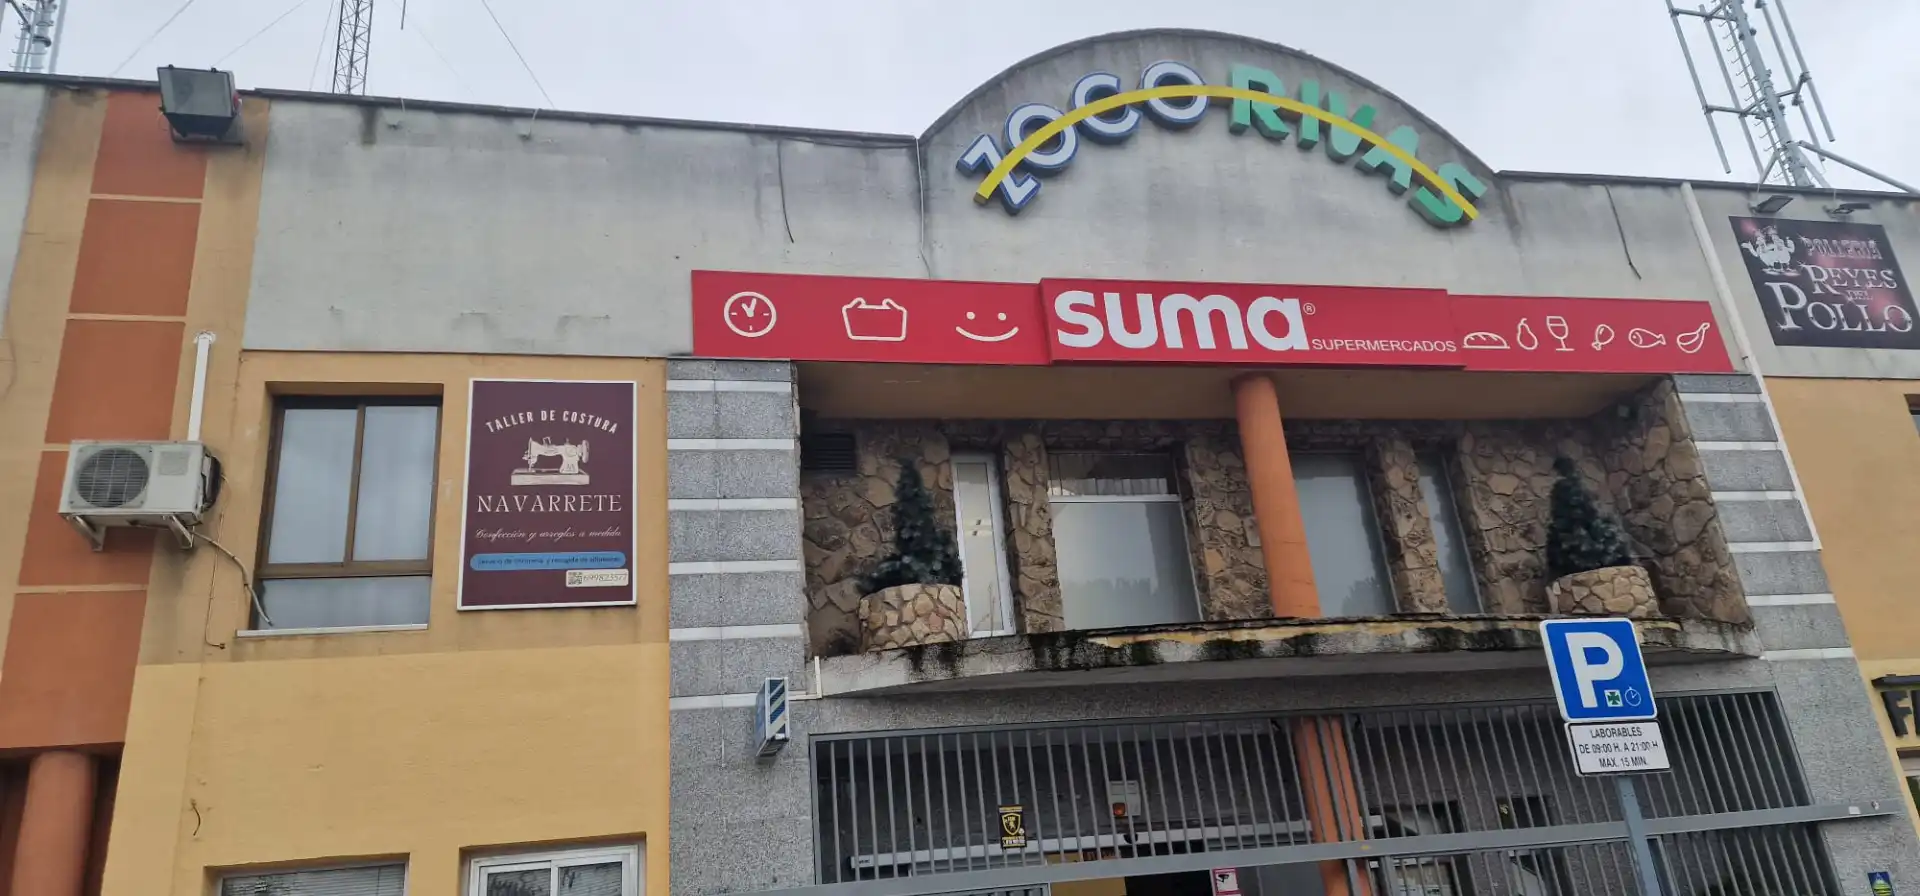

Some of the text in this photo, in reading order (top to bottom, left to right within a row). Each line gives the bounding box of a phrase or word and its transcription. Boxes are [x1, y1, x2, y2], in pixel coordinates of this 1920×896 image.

[956, 59, 1488, 227] ZOCO RIVAS
[1800, 263, 1898, 295] REYES
[1764, 281, 1913, 333] POLLO
[1054, 290, 1309, 351] suma
[1312, 338, 1457, 352] SUPERMERCADOS
[485, 410, 618, 434] TALLER DE COSTURA
[477, 494, 622, 513] NAVARRETE
[526, 532, 537, 543] y
[539, 527, 576, 542] arreglos
[589, 526, 621, 538] medida
[1564, 631, 1624, 708] P
[1590, 727, 1643, 739] LABORABLES
[1579, 744, 1590, 754] DE
[1592, 743, 1613, 753] 09:00
[1624, 742, 1630, 752] A
[1599, 757, 1619, 769] MAX.
[1620, 757, 1630, 767] 15
